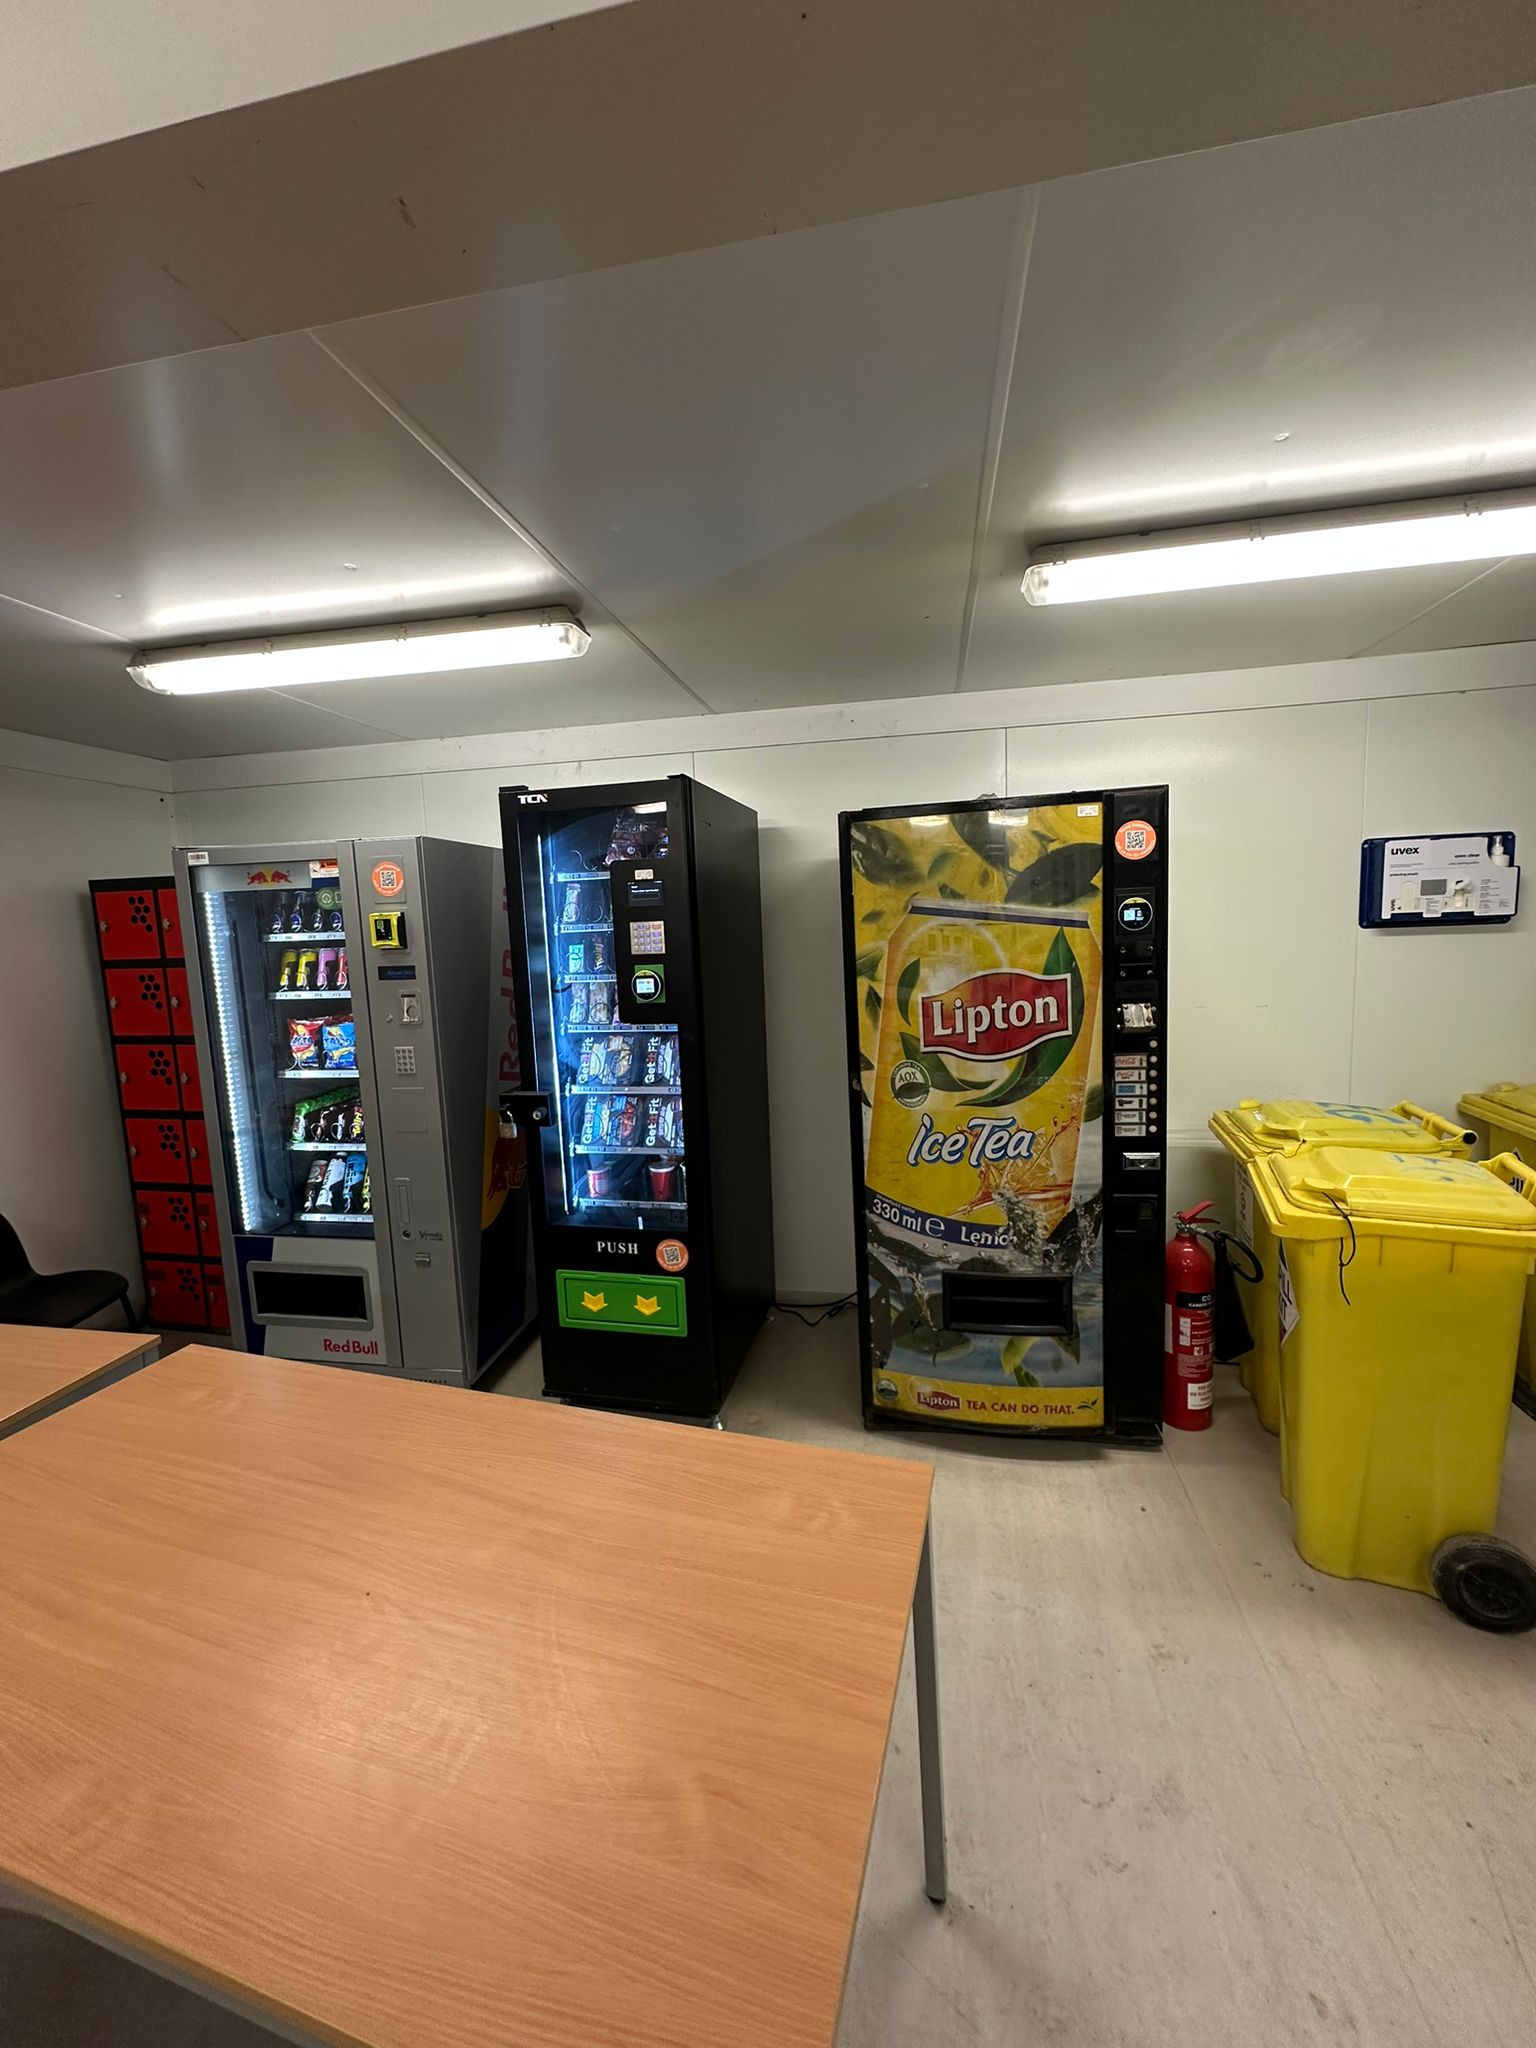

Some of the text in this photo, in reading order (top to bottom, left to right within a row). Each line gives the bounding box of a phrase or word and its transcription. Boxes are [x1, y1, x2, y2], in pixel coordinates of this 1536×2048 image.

[517, 793, 548, 805] TCN
[1391, 846, 1420, 856] uvex
[931, 994, 1060, 1044] Lipton
[898, 1070, 919, 1083] AOX
[907, 1113, 1036, 1169] Ice Tea
[872, 1198, 900, 1223] 330
[902, 1214, 922, 1232] ml
[596, 1240, 639, 1255] PUSH
[323, 1338, 379, 1355] Red Bull
[920, 1393, 1075, 1415] Lipton TEA CAN DO THAT.
